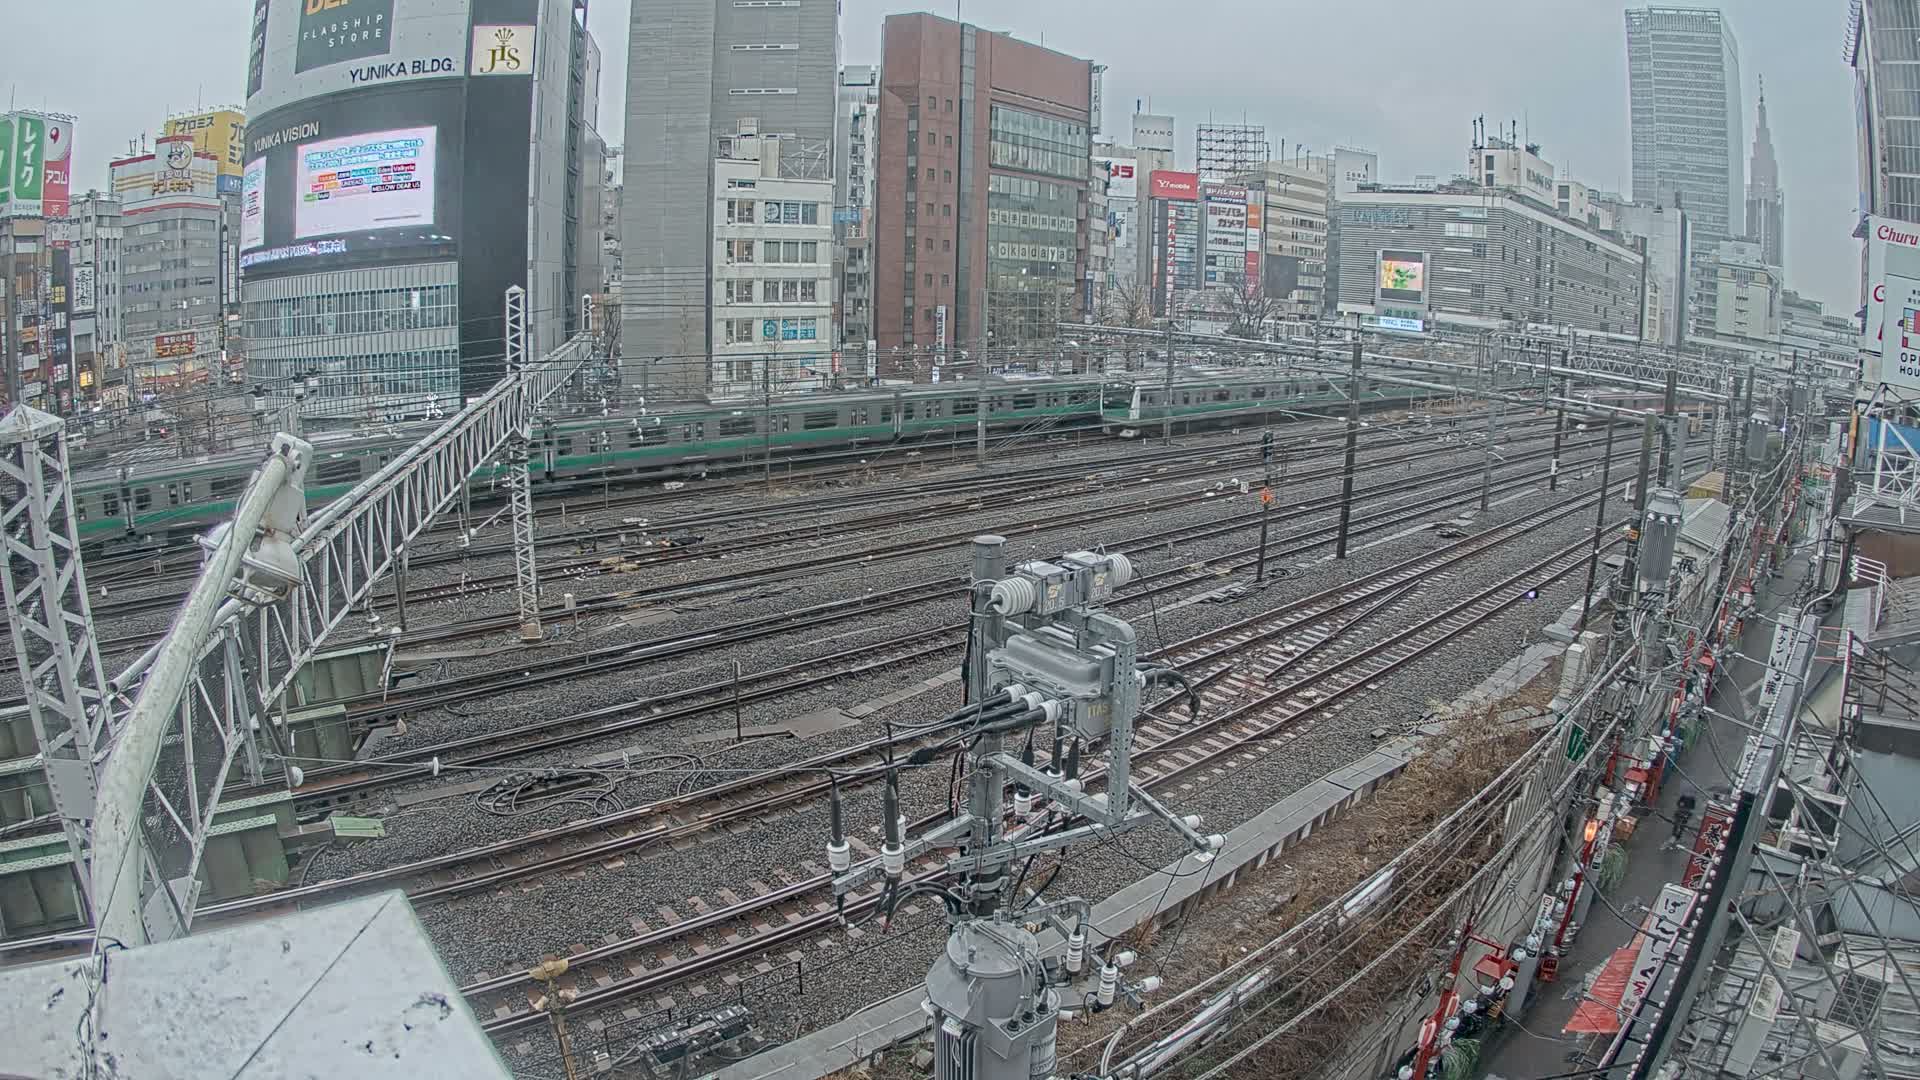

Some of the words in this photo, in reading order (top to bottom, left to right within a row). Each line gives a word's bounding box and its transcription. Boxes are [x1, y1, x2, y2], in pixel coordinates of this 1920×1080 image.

[303, 14, 383, 41] FLAGSHIP
[328, 28, 382, 48] STORE
[349, 62, 408, 83] YUNIKA
[411, 57, 456, 76] BLDG.
[175, 116, 215, 132] プロミス
[1134, 127, 1173, 137] TAKANO
[254, 130, 281, 153] YUNIKA
[282, 120, 320, 144] VISION
[21, 121, 37, 188] レイク
[45, 169, 68, 185] アコム
[1877, 224, 1919, 247] Churu
[999, 244, 1065, 262] okadaya
[1900, 352, 1920, 367] OP
